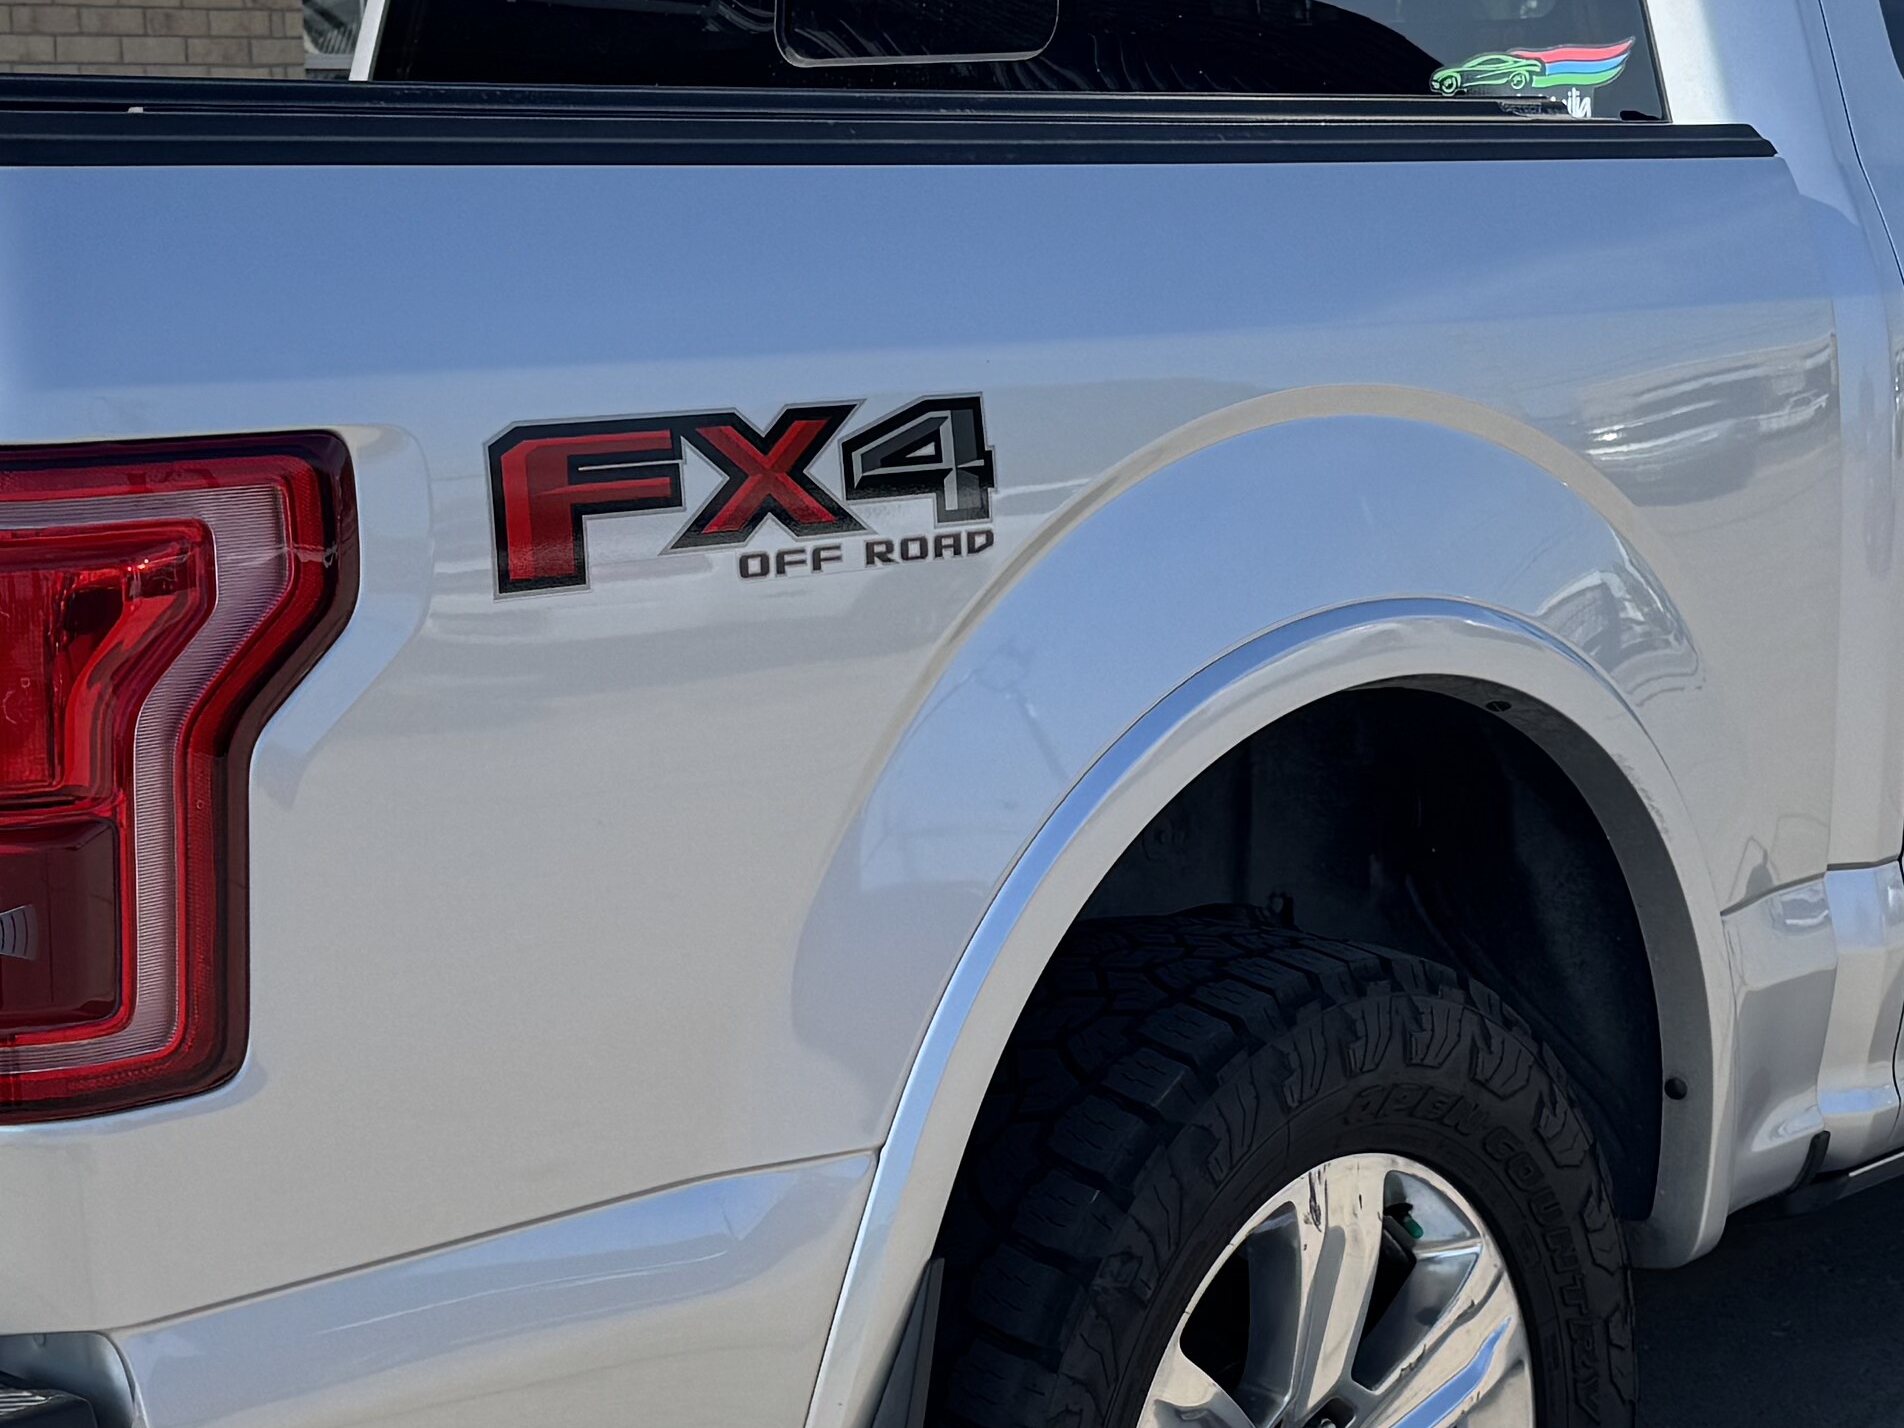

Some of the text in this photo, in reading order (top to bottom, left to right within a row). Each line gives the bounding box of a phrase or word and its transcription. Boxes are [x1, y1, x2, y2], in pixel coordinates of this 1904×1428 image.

[484, 392, 995, 600] FX4
[738, 529, 995, 580] OFF ROAD
